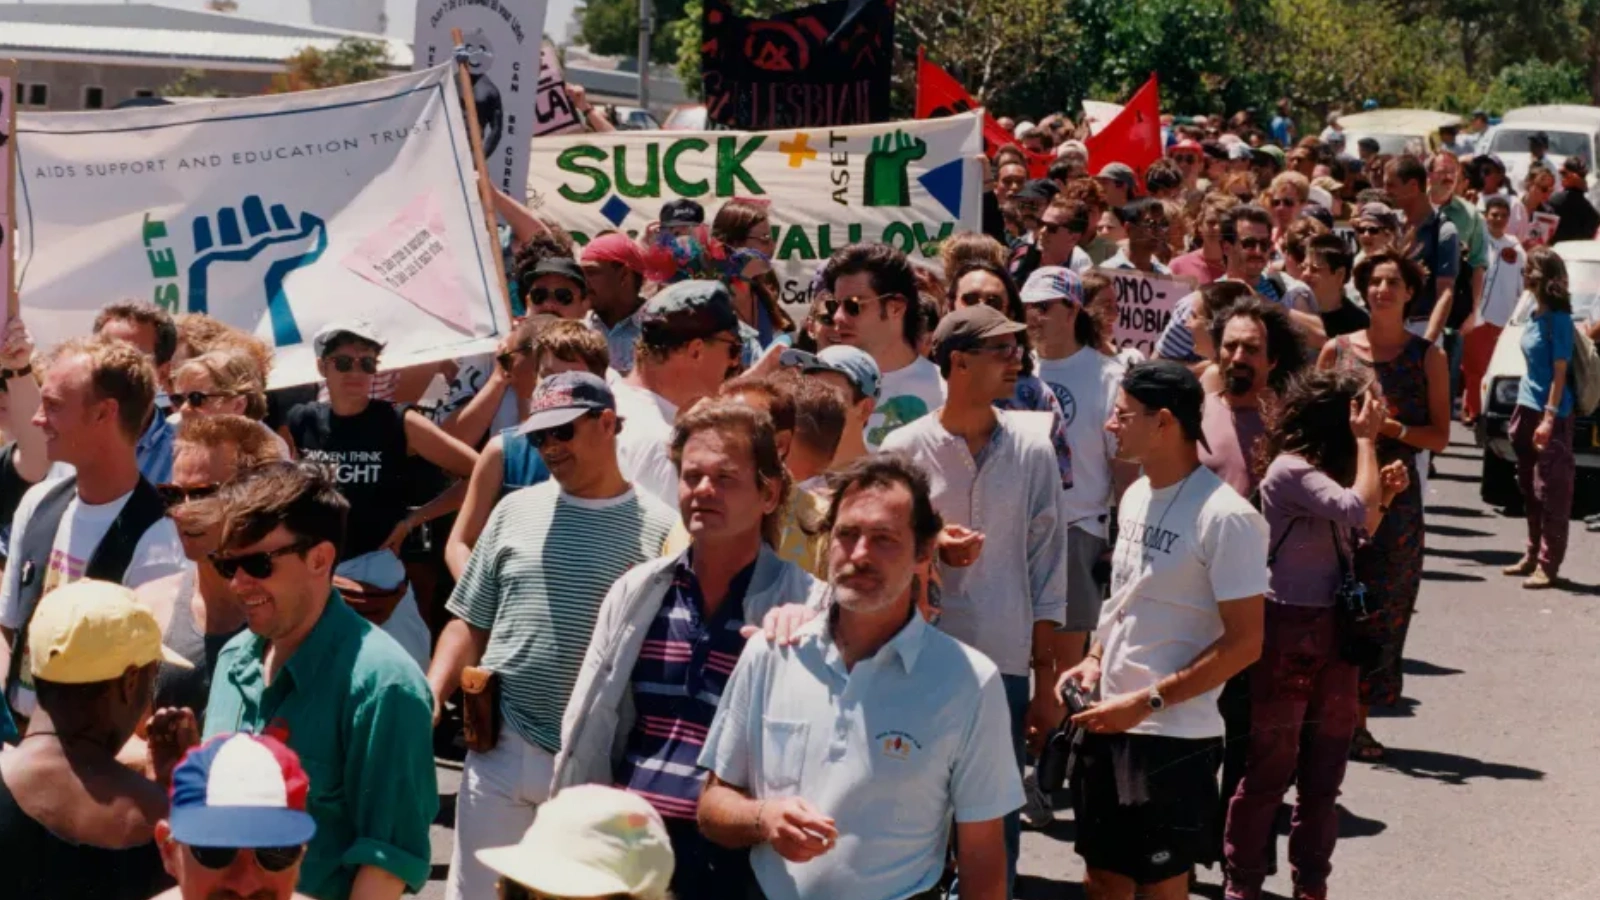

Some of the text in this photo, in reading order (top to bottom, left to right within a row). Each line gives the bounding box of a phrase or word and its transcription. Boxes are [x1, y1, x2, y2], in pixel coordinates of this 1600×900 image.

[511, 61, 520, 93] CAN
[35, 119, 434, 179] AIDS SUPPORT AND EDUCATION TRUST
[556, 134, 770, 203] SUCK
[827, 130, 849, 207] ASET
[1115, 305, 1172, 333] HOBIA
[349, 450, 383, 463] THINK
